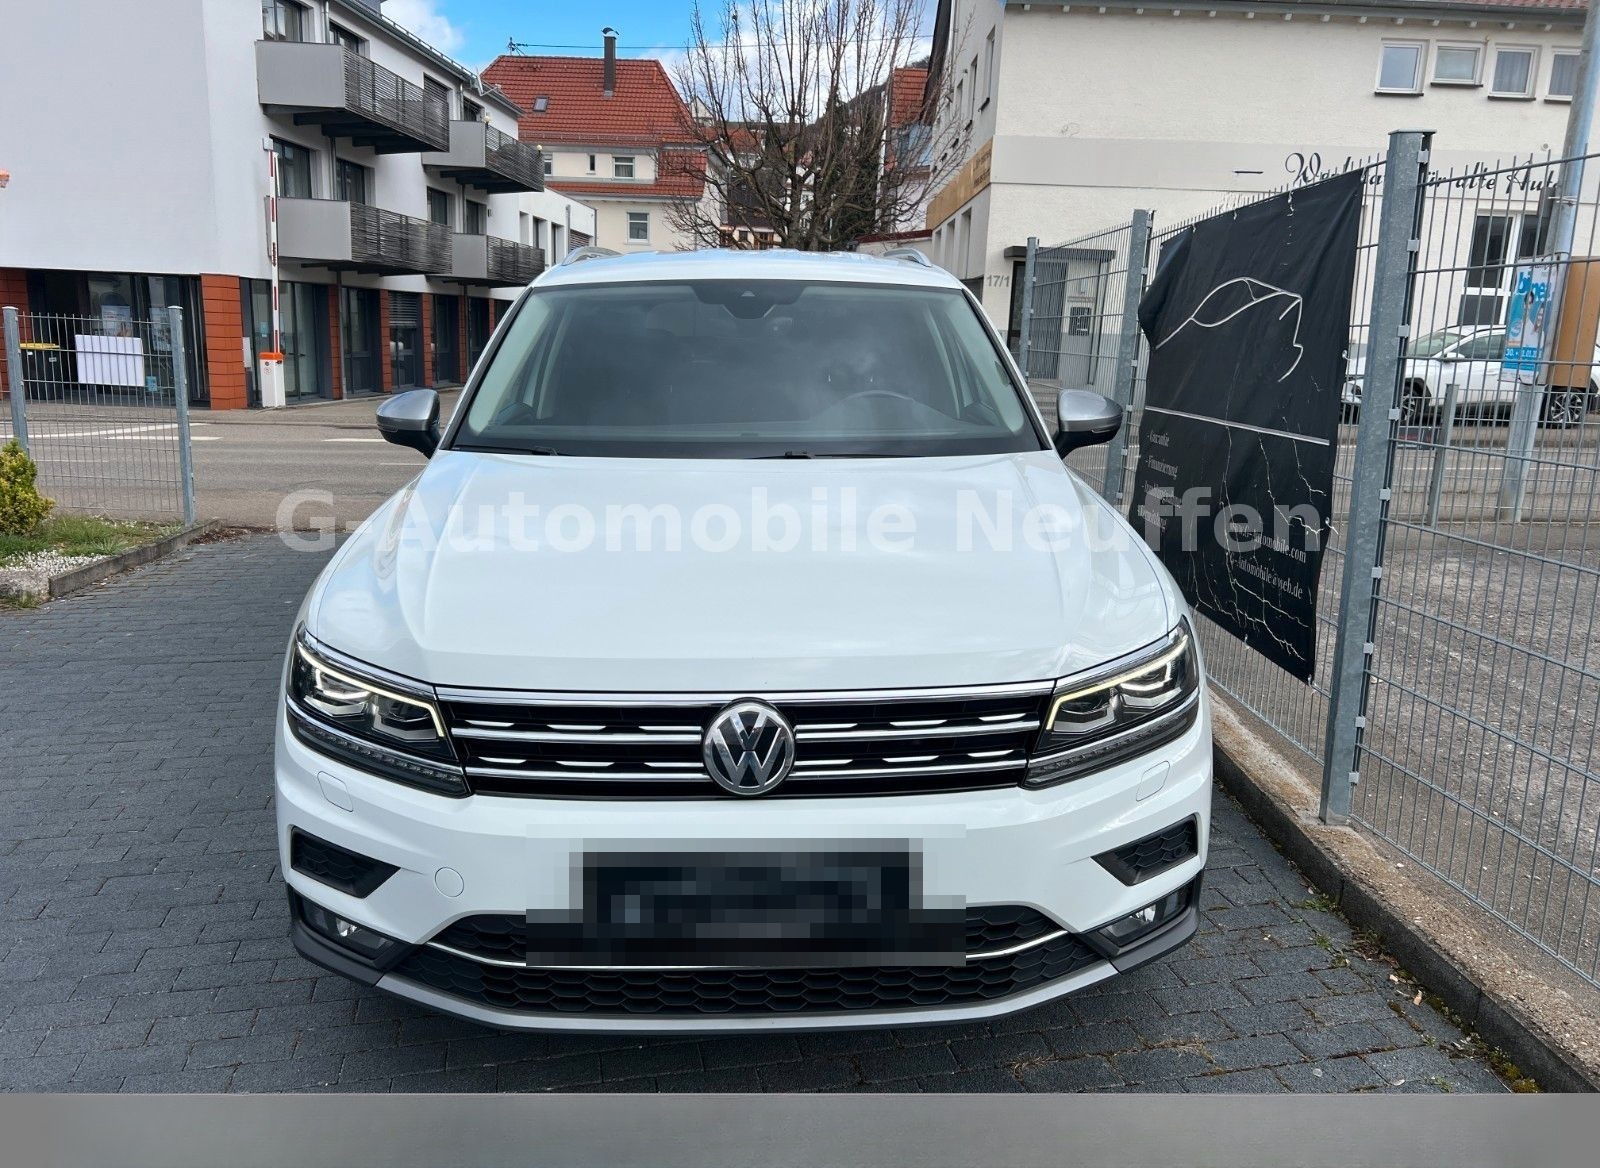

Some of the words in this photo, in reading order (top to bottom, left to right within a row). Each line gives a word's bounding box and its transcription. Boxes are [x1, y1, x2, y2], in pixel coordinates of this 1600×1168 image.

[1455, 161, 1497, 190] alte
[986, 275, 1010, 288] 17/1
[706, 702, 790, 793] VW
